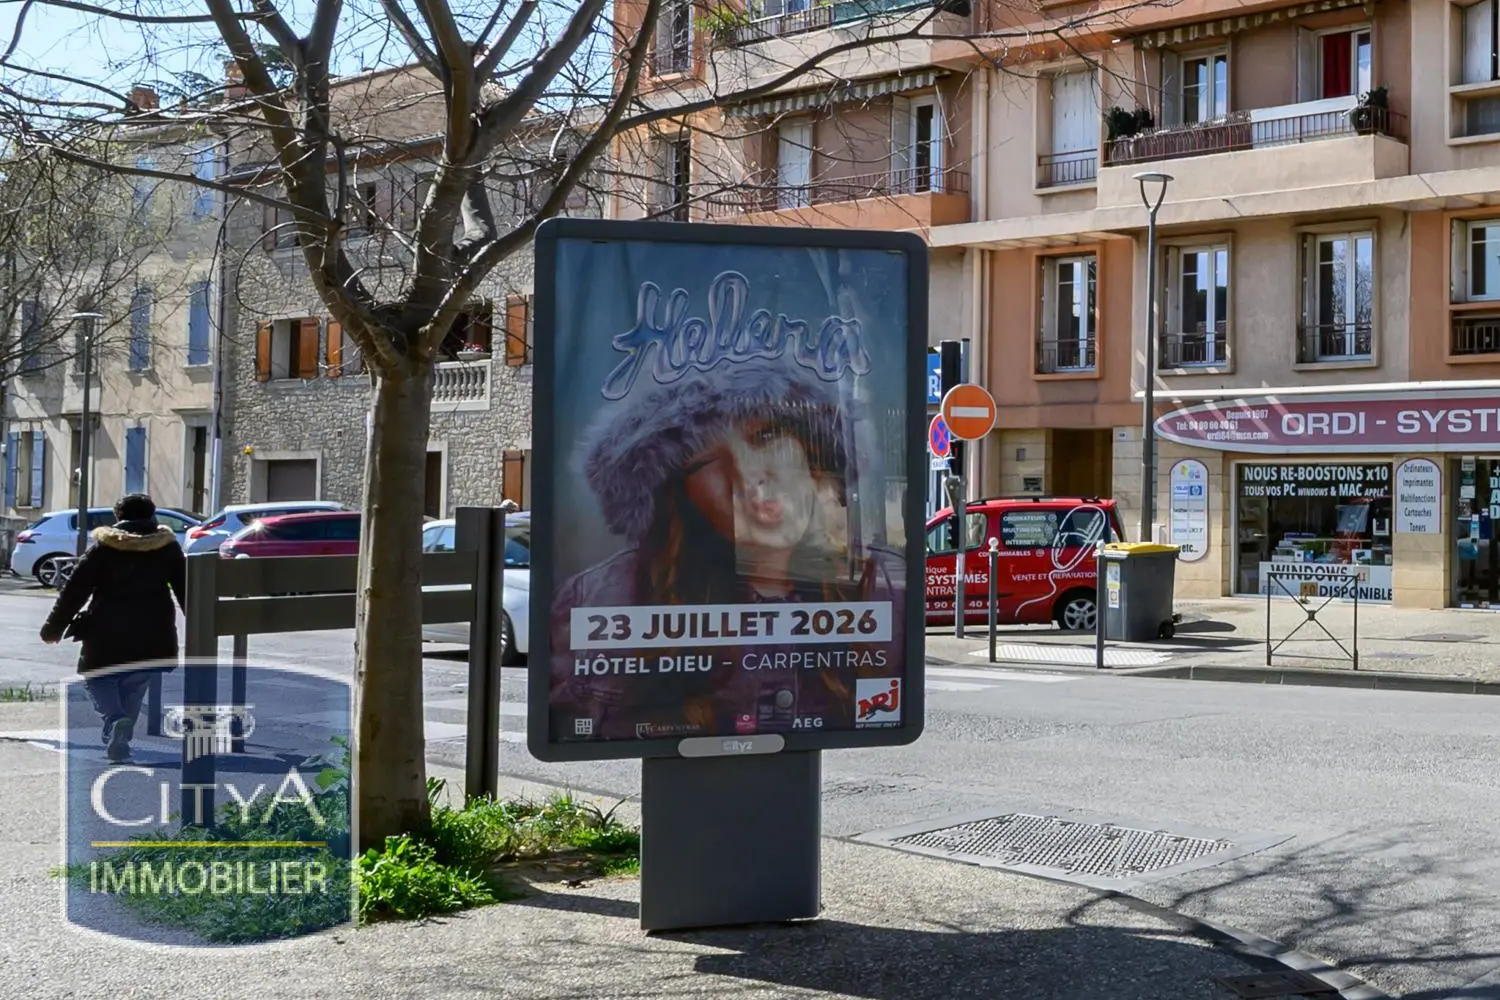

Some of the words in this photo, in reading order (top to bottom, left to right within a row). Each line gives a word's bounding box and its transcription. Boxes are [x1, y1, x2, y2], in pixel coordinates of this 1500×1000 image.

[1281, 411, 1365, 436] ORDI
[1244, 466, 1277, 481] NOUS
[1280, 466, 1364, 481] RE-BOOSTONS
[1366, 466, 1389, 481] x10
[1404, 463, 1433, 473] Ordinateurs
[1403, 478, 1434, 488] Imprimantes
[1244, 485, 1264, 497] TOUS
[1265, 485, 1281, 497] VOS
[1283, 483, 1296, 497] PC
[1298, 487, 1328, 497] WINDOWS
[1339, 483, 1363, 497] MAC
[1404, 507, 1432, 517] Cartouches
[1410, 522, 1426, 532] Toners
[1012, 573, 1037, 581] VENTE
[1038, 572, 1048, 581] ET
[1271, 564, 1348, 582] WINDOWS
[1320, 585, 1392, 601] DISPONIBLE
[969, 600, 982, 608] 40
[587, 614, 632, 641] 23
[642, 611, 780, 640] JUILLET
[790, 609, 878, 636] 2026
[574, 653, 650, 676] HÔTEL
[658, 655, 713, 673] DIEU
[742, 649, 887, 671] CARPENTRAS
[792, 717, 824, 729] AEG
